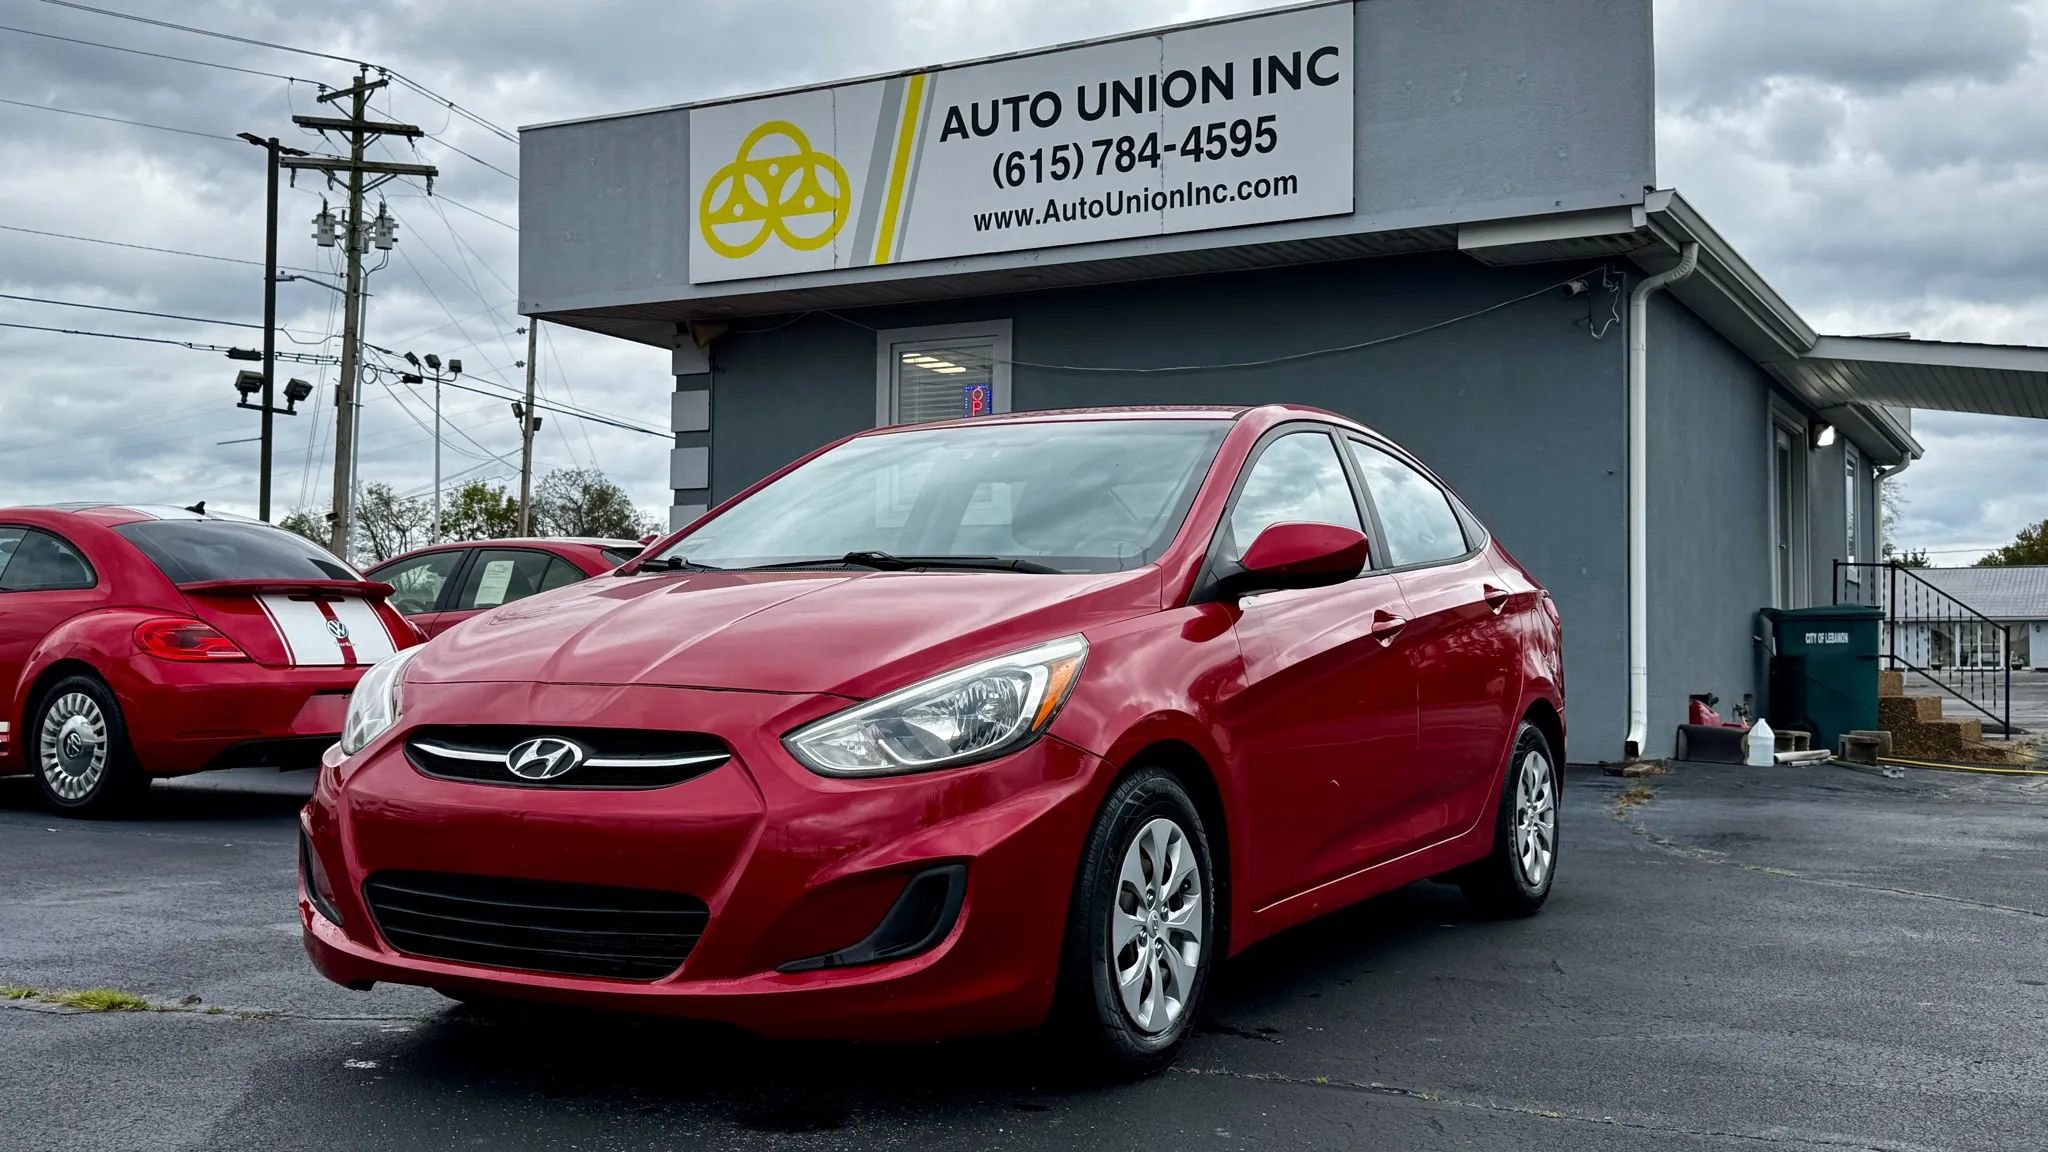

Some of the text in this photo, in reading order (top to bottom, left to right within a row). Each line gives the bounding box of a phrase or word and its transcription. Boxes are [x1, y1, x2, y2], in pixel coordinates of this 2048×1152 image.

[940, 46, 1339, 142] AUTO UNION INC
[993, 115, 1277, 189] (615) 784-4595
[974, 175, 1297, 231] www.AutoUnionInc.com
[1805, 632, 1849, 644] CITY OF LEBANON
